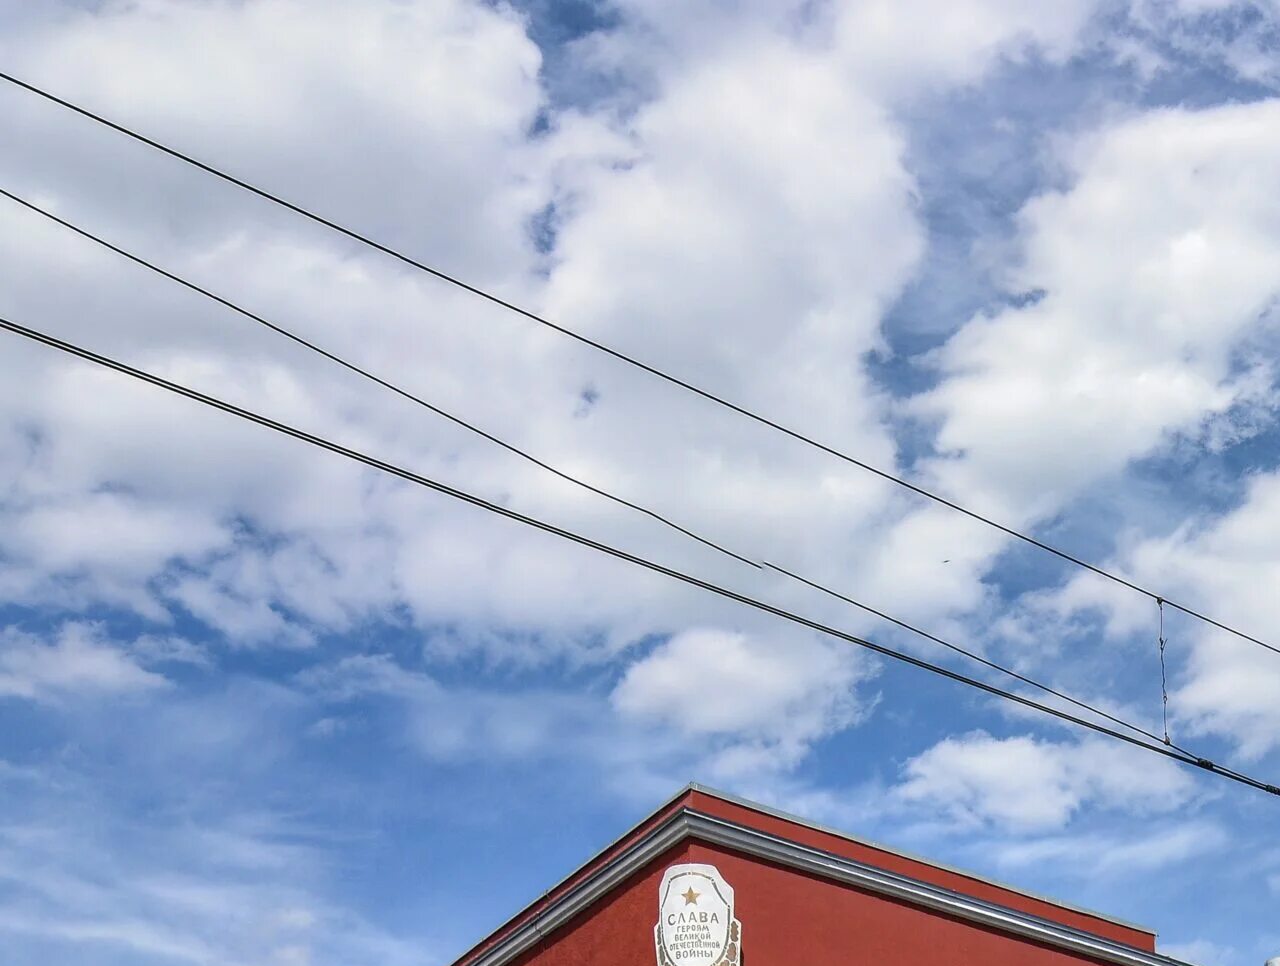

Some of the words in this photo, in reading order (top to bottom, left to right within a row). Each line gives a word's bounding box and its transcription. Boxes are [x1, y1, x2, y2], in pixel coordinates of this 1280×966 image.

[668, 912, 718, 926] СЛАВА
[676, 924, 710, 932] ГЕРОЯМ
[674, 932, 710, 942] ВЕЛИКОЙ
[670, 942, 720, 950] ОТЕЧЕСТВЕННОЙ
[676, 950, 712, 960] ВОЙНЫ
